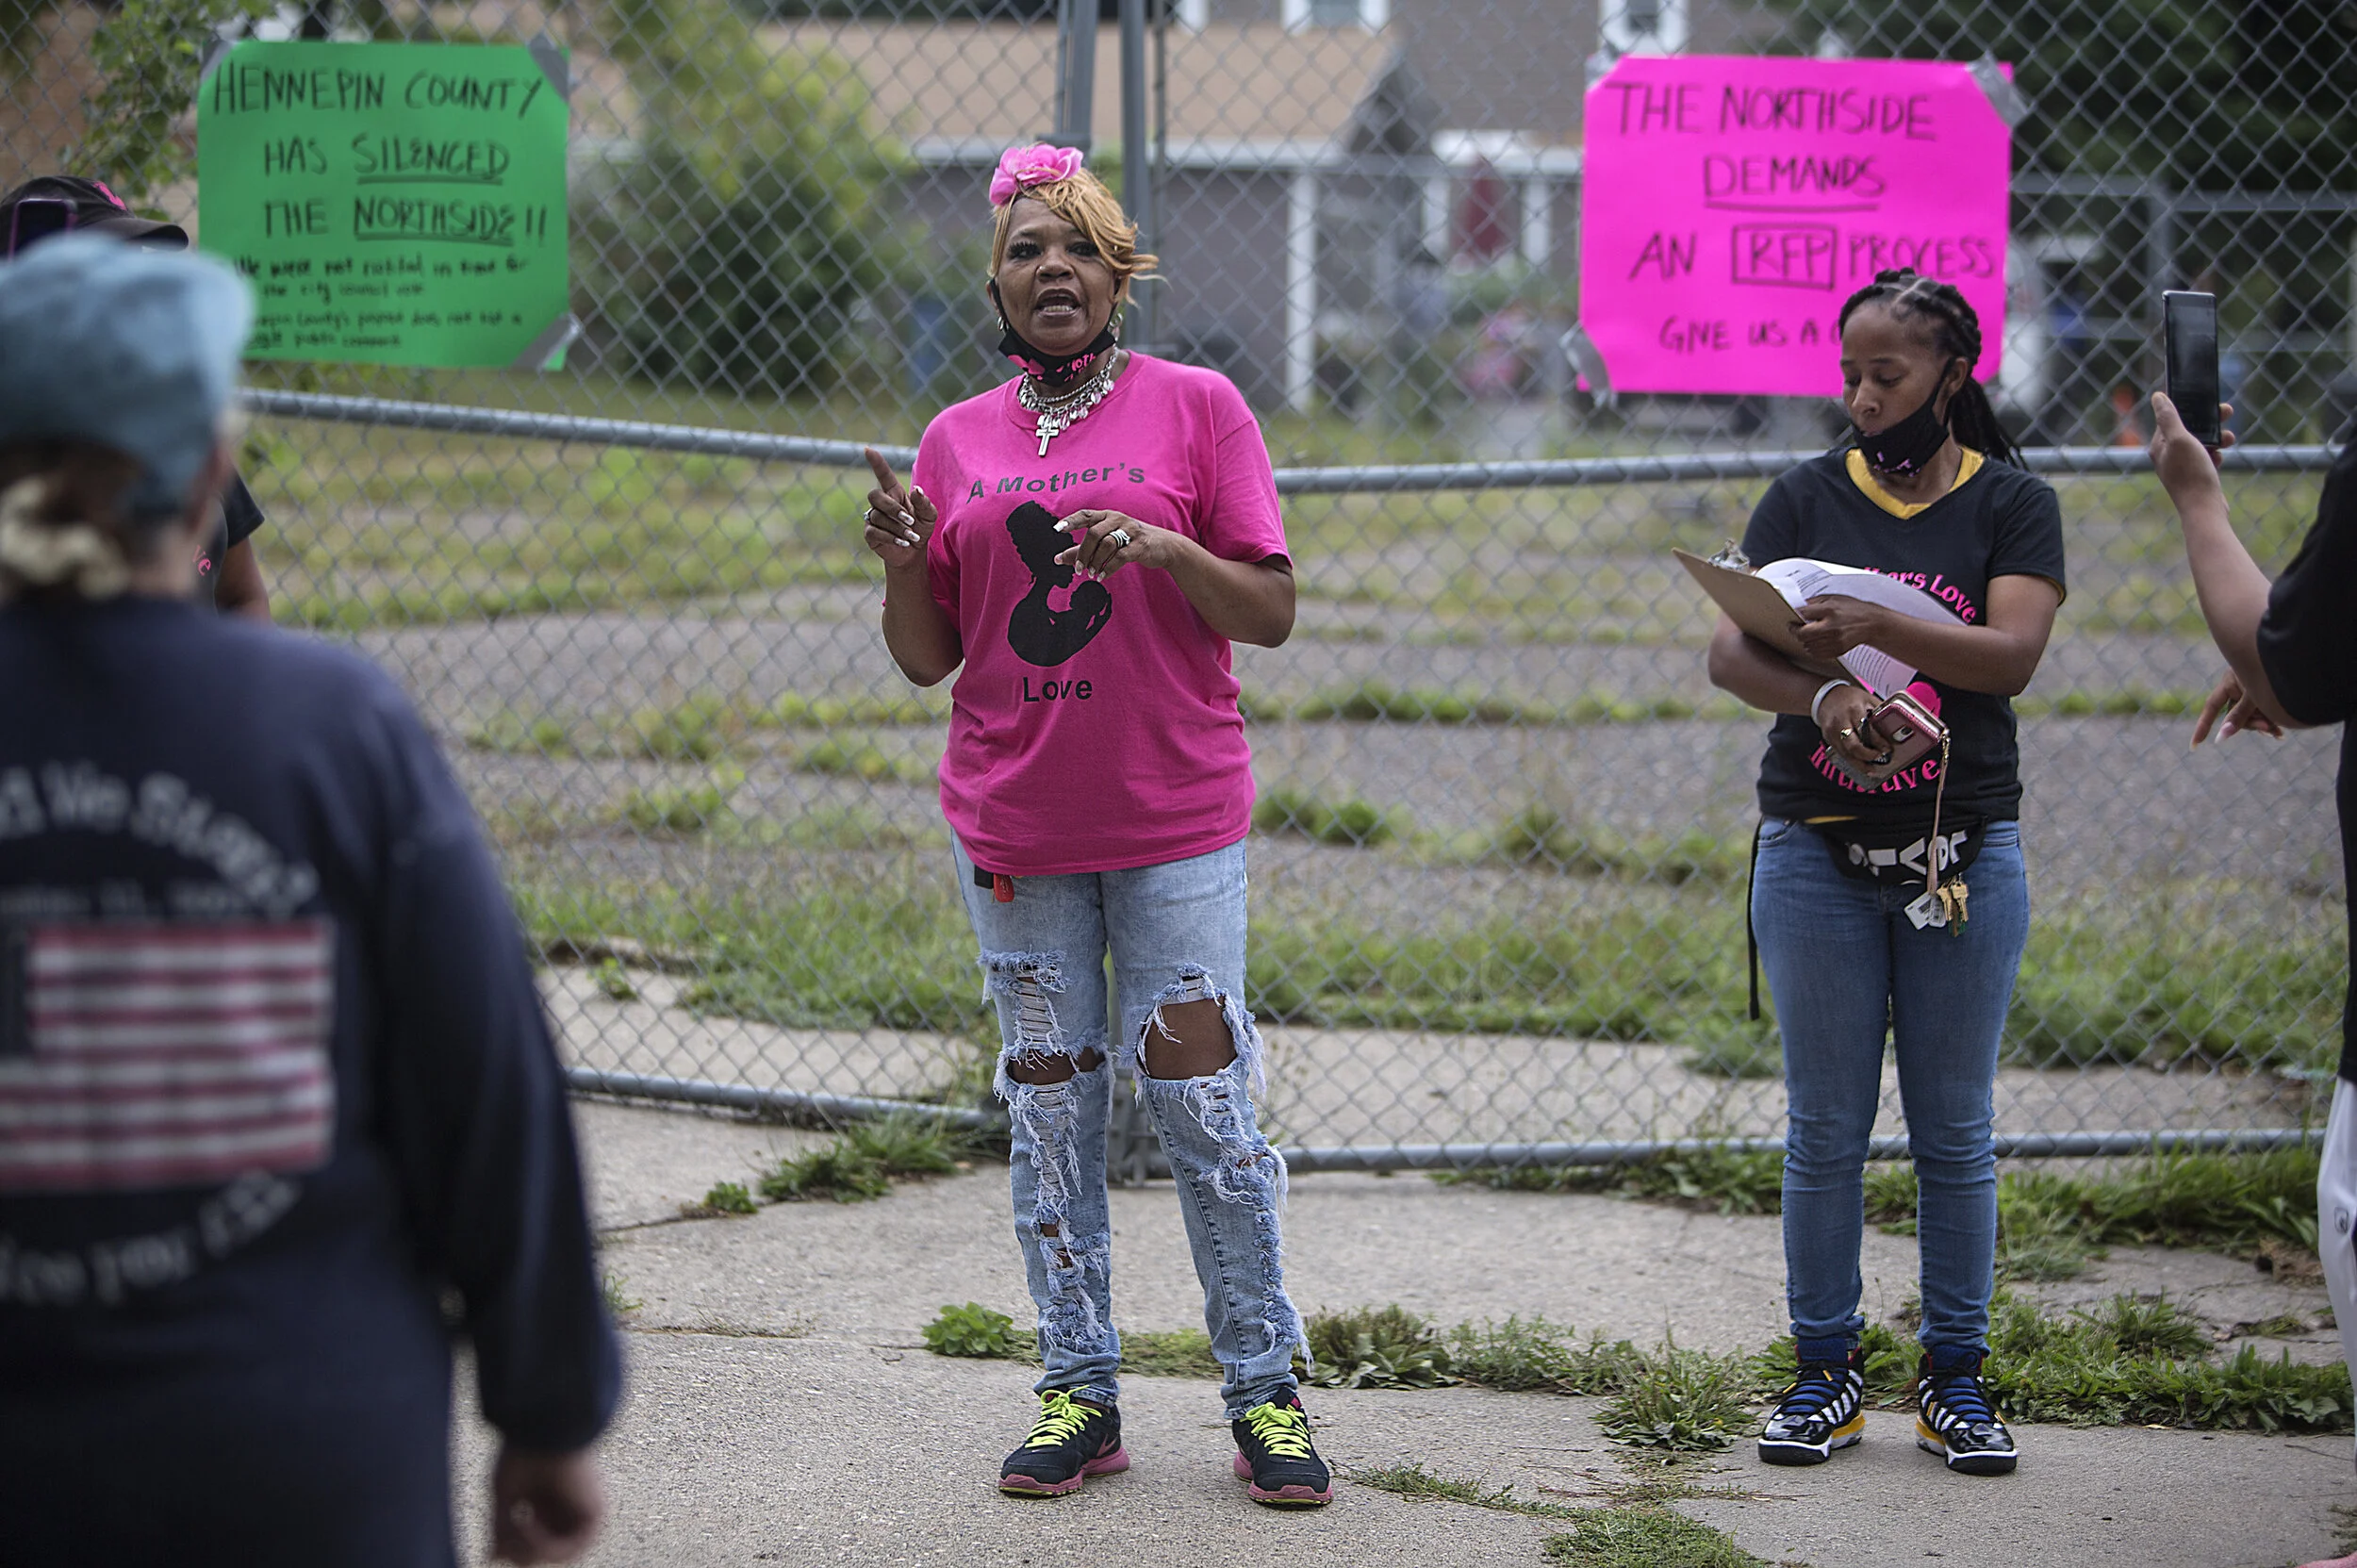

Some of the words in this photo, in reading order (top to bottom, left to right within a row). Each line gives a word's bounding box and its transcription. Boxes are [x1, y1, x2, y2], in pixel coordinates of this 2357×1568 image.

[214, 60, 386, 114] HENNEPIN
[404, 69, 543, 120] COUNTY
[1605, 81, 1703, 135] THE
[1718, 86, 1938, 141] NORTHSIDE
[264, 135, 328, 177] HAS
[351, 132, 510, 181] SILENCED
[1703, 153, 1886, 197] DEMANDS
[263, 196, 329, 239] THE
[1629, 231, 1696, 281] AN
[1748, 231, 1831, 279] RFP
[1848, 235, 1995, 280] PROCESS
[1659, 316, 1733, 354] GIVE
[1747, 319, 1786, 349] US
[1800, 318, 1820, 346] A
[966, 480, 984, 505] A
[996, 462, 1146, 494] Mother's
[1929, 573, 1977, 623] Love
[1023, 676, 1093, 702] Love
